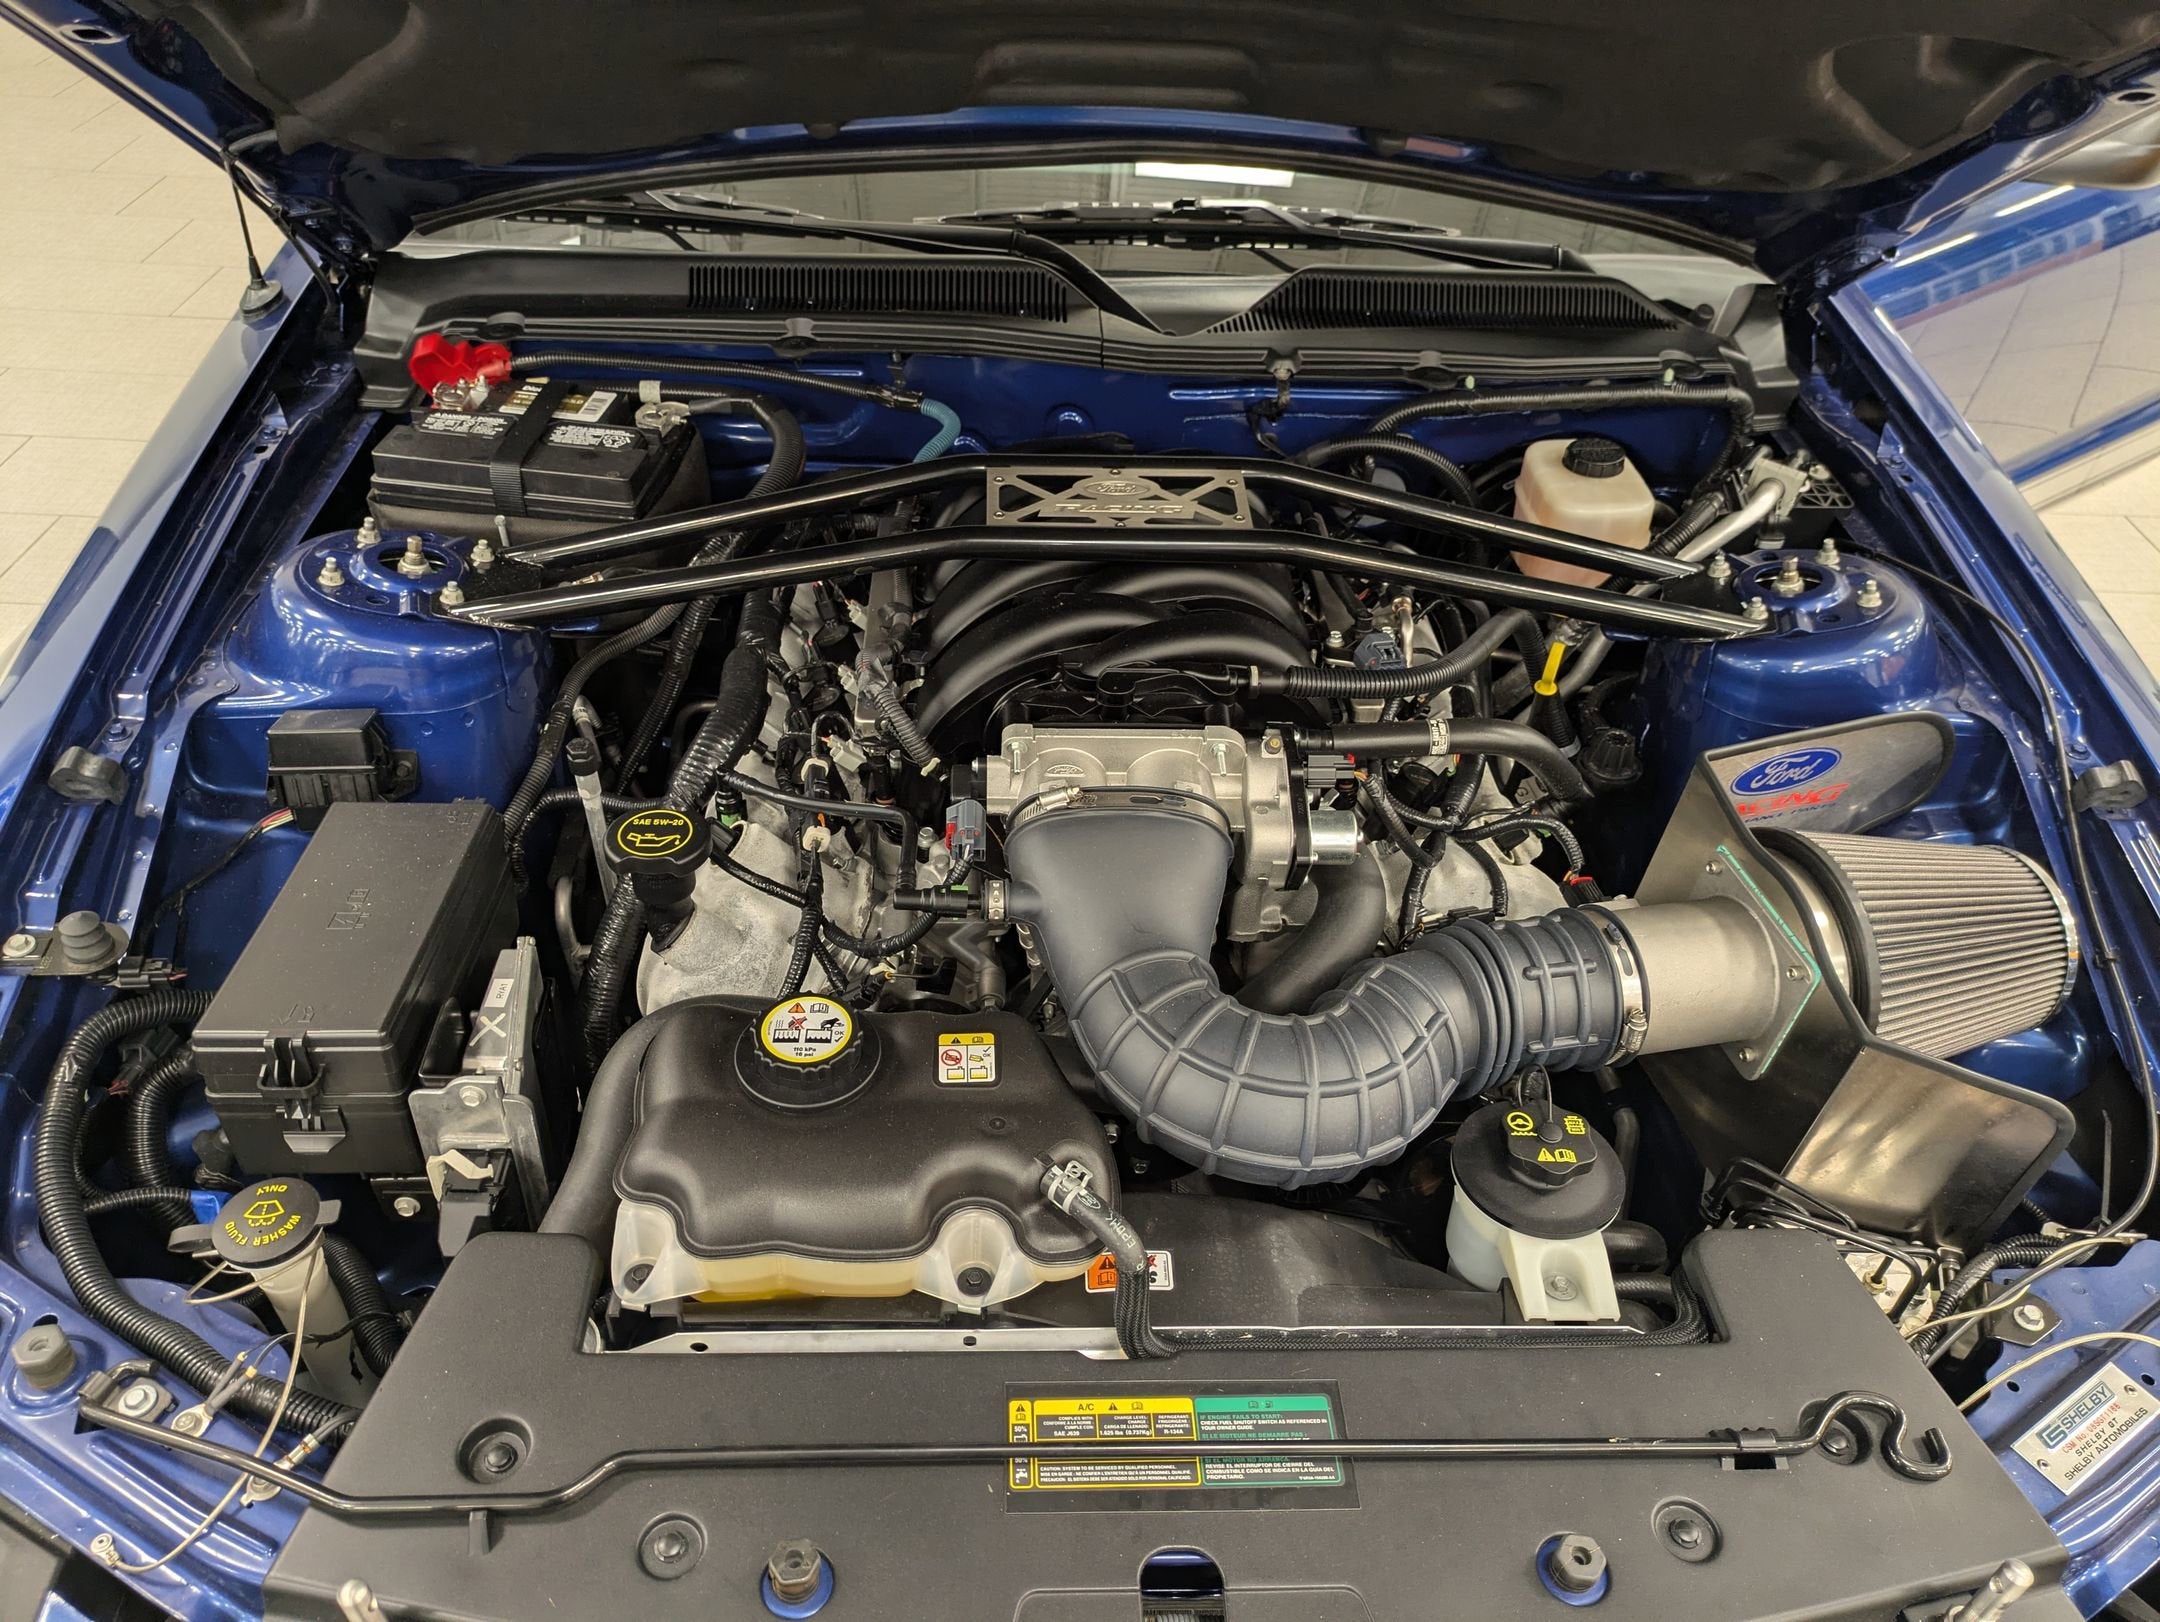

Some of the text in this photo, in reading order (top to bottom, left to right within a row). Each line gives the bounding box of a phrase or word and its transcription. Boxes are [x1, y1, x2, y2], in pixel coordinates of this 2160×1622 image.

[1750, 755, 1823, 789] Ford
[633, 818, 684, 826] SAE 5W-20
[256, 1184, 288, 1196] ONLY
[225, 1215, 301, 1246] WASHER FLUID
[1078, 1403, 1094, 1411] A/C
[2060, 1385, 2108, 1430] SHELBY
[2064, 1407, 2149, 1481] SHELBY AUTOMOBILES
[2075, 1417, 2119, 1457] SHELBY GT
